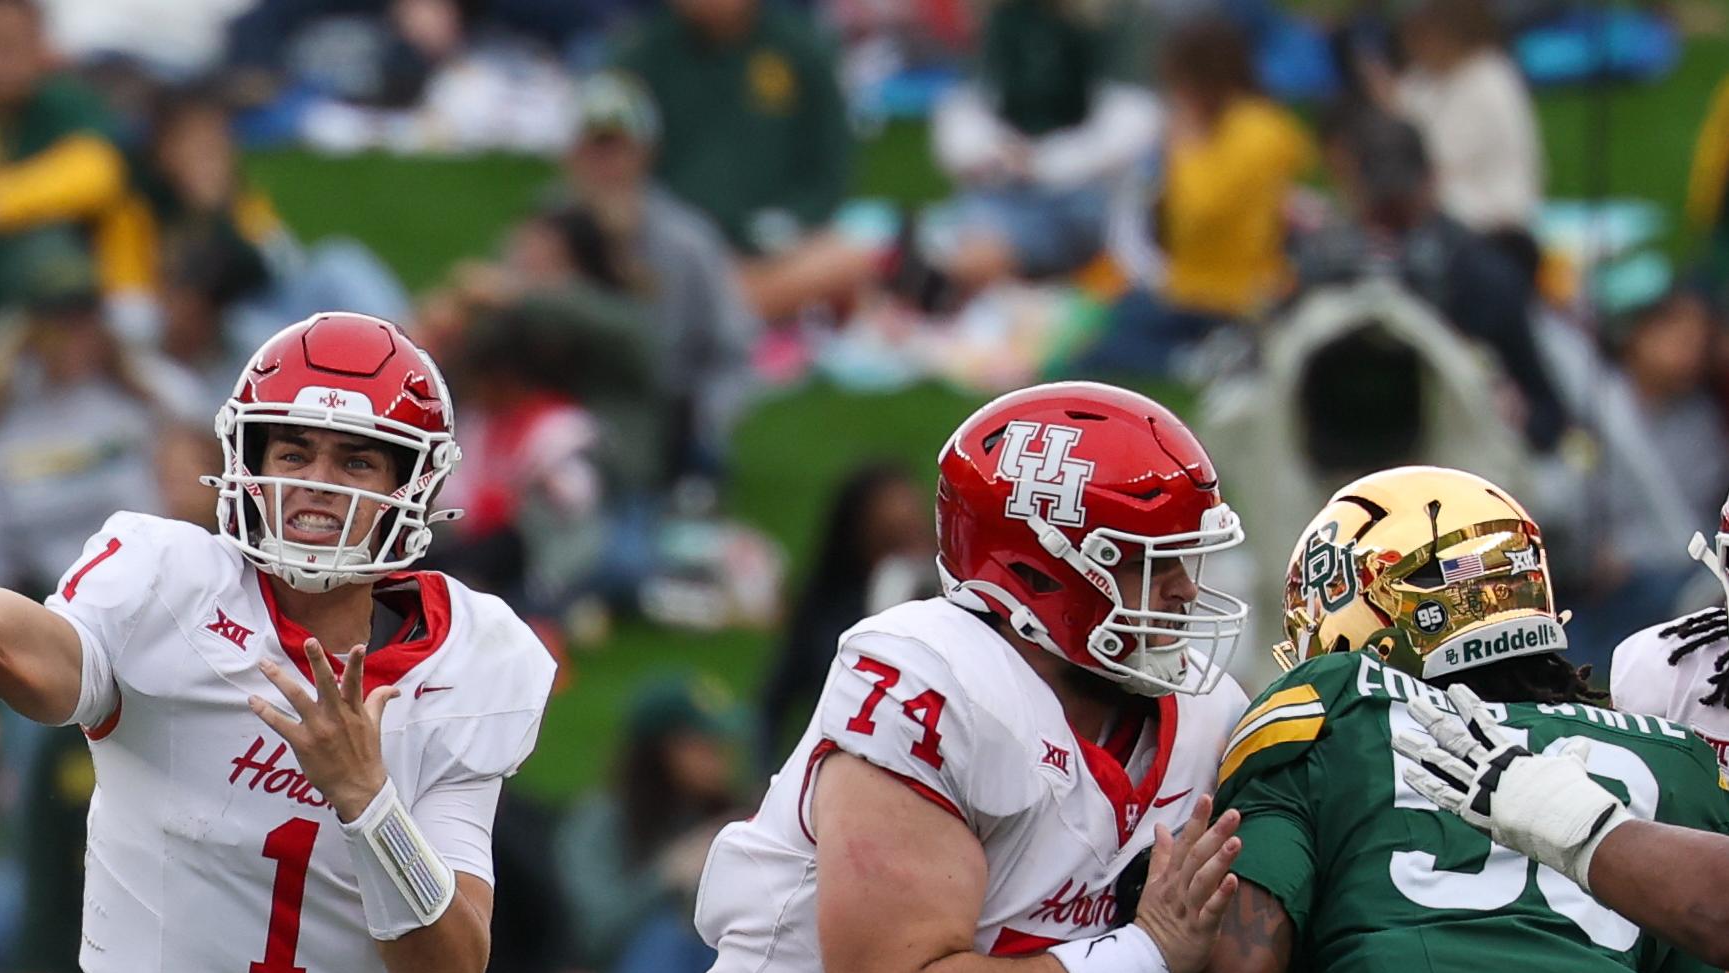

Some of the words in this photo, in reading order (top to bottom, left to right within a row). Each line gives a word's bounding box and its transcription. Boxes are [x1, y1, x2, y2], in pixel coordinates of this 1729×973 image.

[998, 420, 1096, 528] UH
[62, 537, 123, 603] 1
[1301, 520, 1359, 615] BU
[205, 606, 255, 652] XII
[1417, 604, 1443, 627] 95
[1462, 623, 1549, 663] Riddell
[846, 655, 947, 771] 74
[1040, 738, 1070, 776] XII
